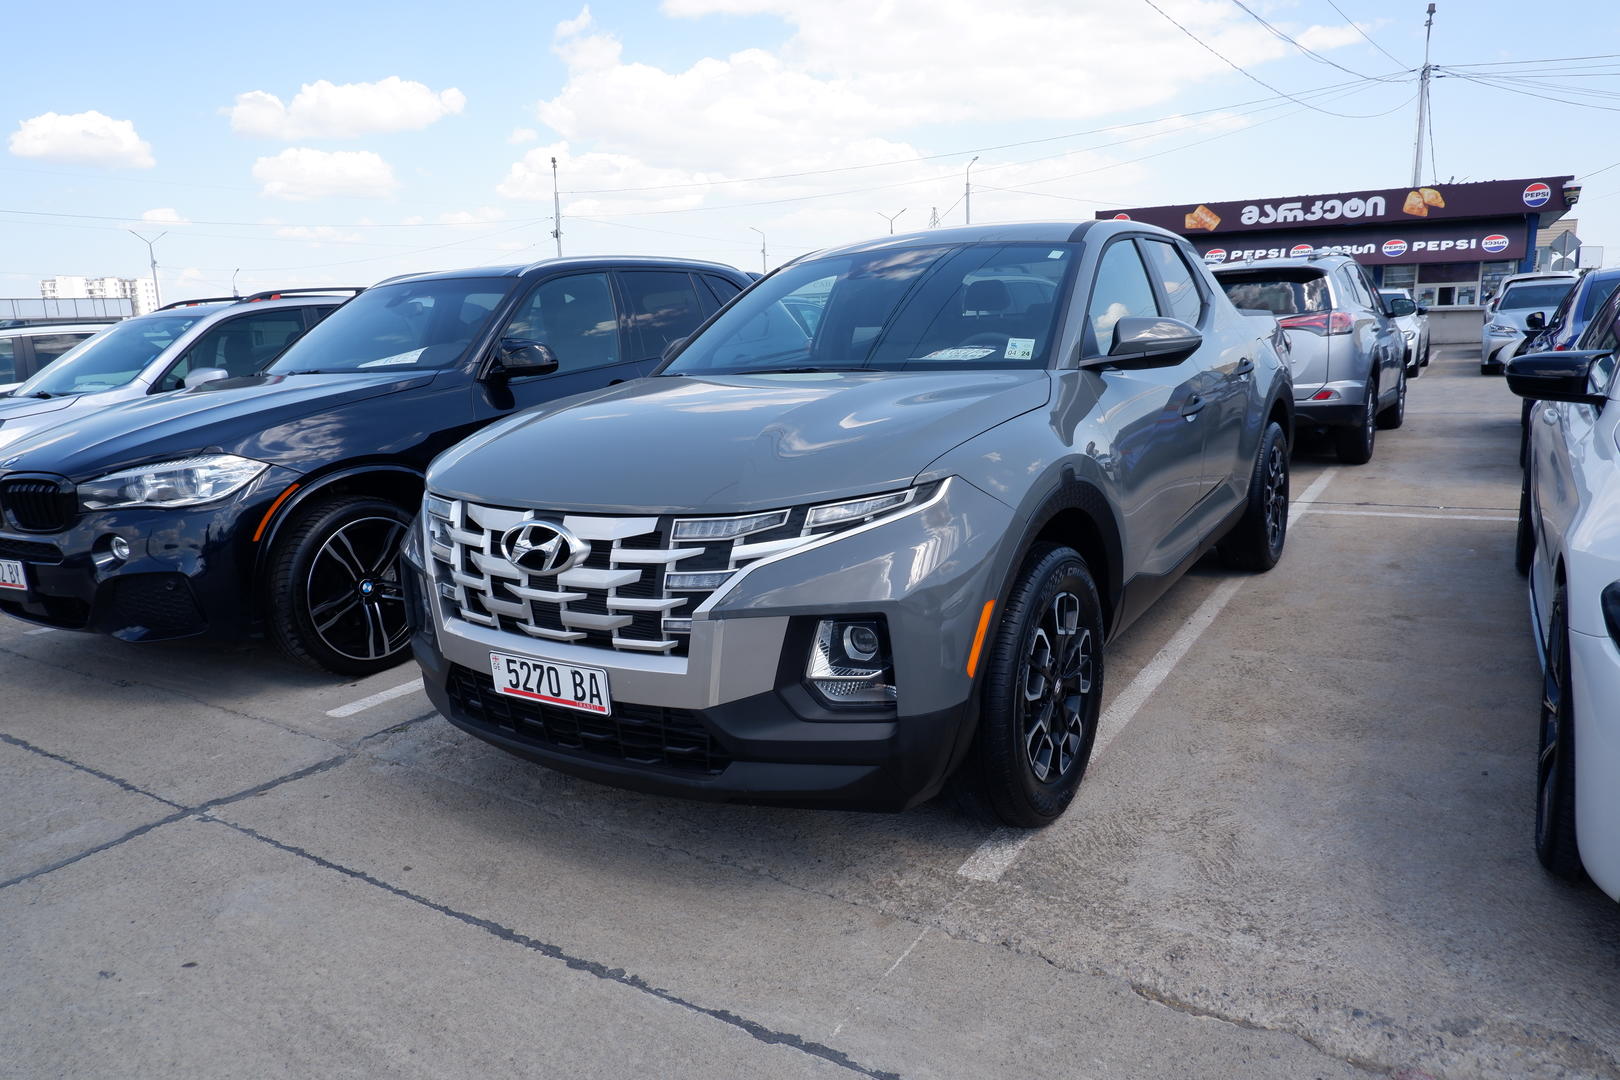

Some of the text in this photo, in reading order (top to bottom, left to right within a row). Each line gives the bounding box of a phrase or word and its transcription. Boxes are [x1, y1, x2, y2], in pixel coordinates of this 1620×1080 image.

[1524, 191, 1549, 199] PEPSI
[1240, 196, 1386, 225] მარკეტი
[1412, 238, 1477, 252] PEPSI
[1230, 247, 1287, 260] PEPSI
[505, 658, 603, 705] 5270 BA
